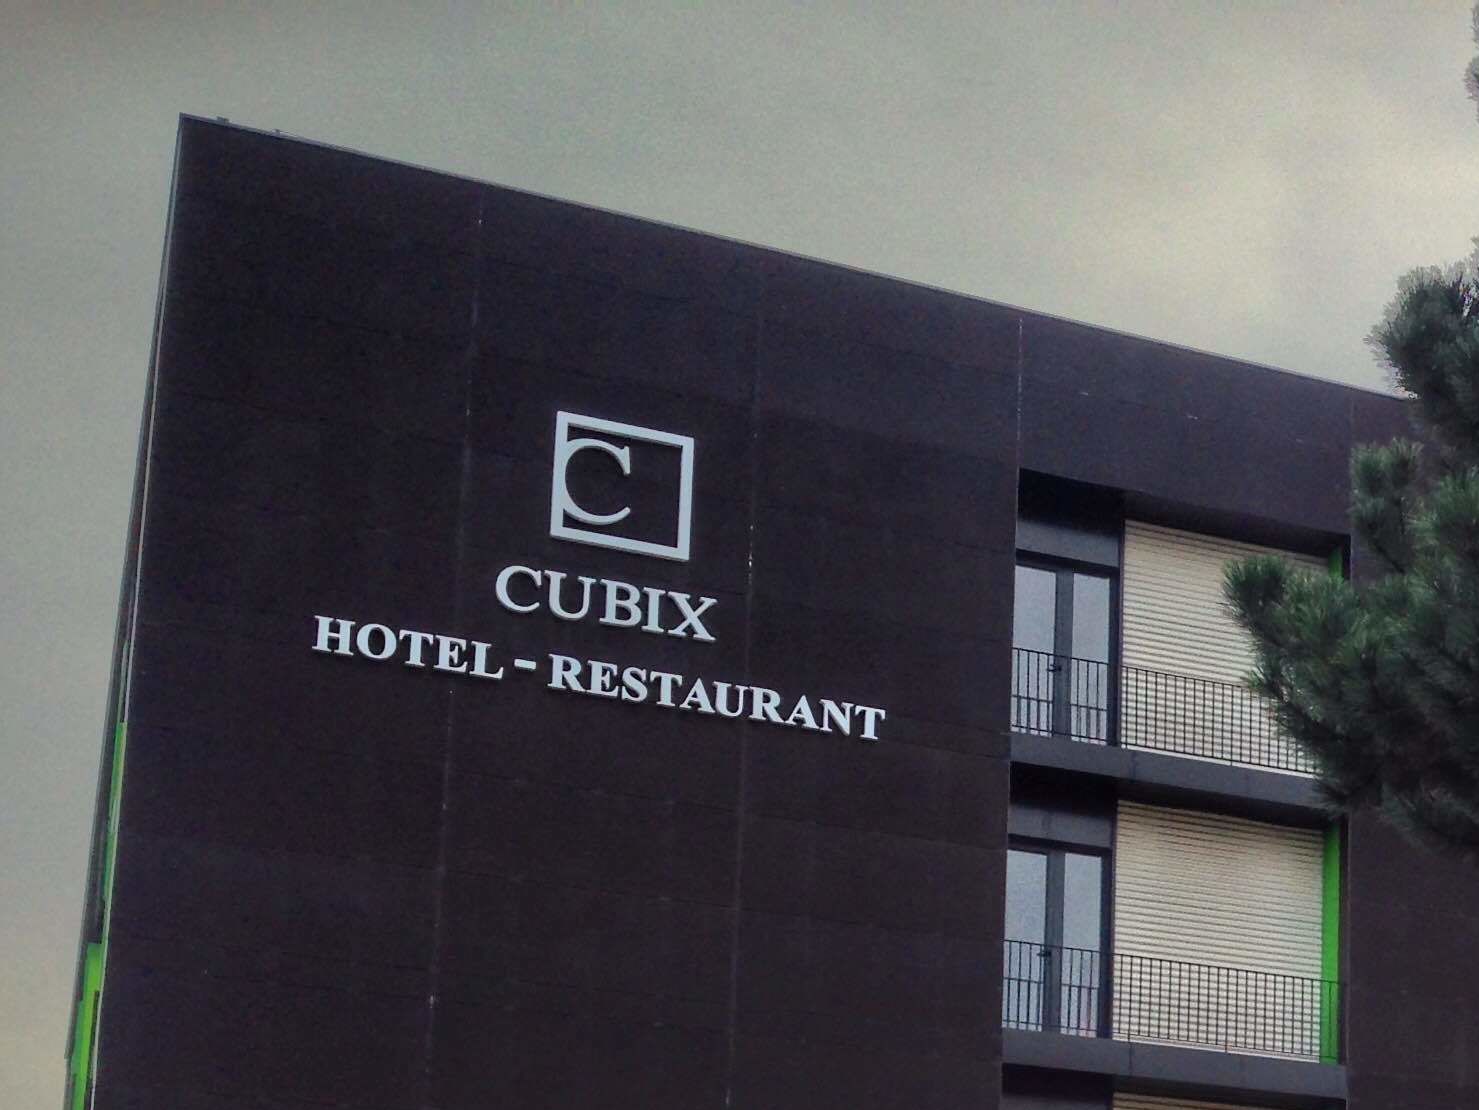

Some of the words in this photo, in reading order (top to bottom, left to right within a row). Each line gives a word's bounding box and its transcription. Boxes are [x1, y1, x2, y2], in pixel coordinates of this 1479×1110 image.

[495, 565, 718, 642] CUBIX
[312, 616, 503, 680] HOTEL
[547, 653, 886, 741] RESTAURANT
